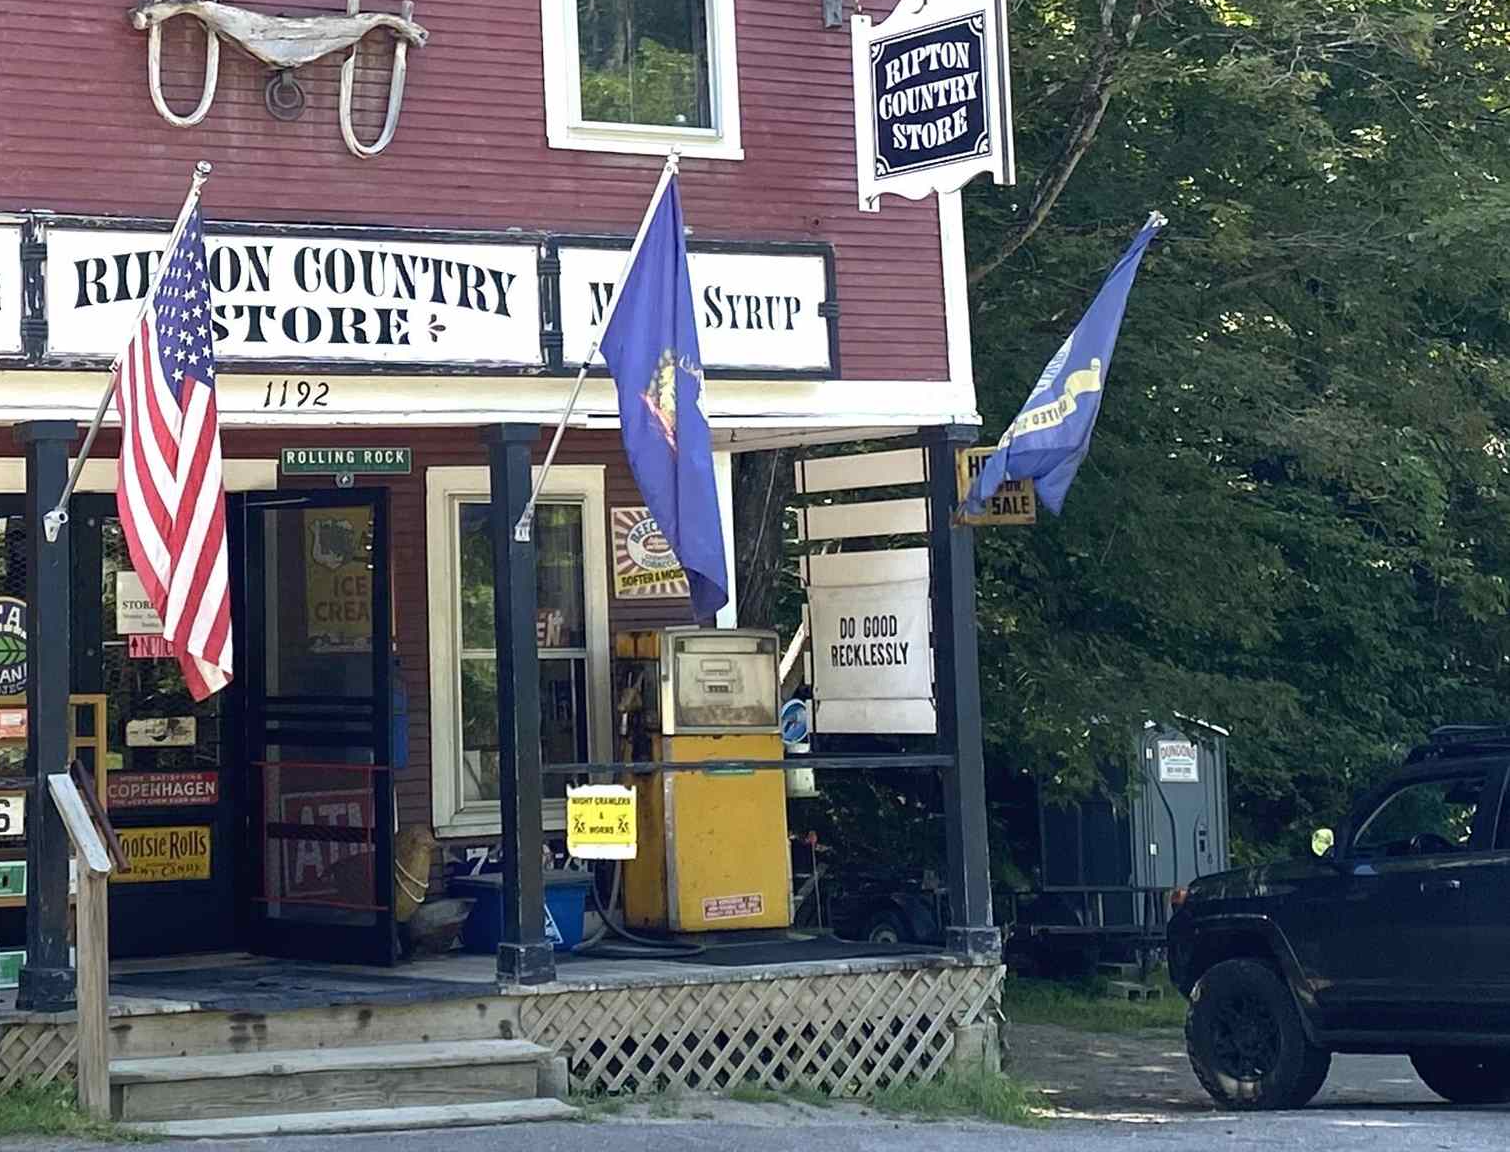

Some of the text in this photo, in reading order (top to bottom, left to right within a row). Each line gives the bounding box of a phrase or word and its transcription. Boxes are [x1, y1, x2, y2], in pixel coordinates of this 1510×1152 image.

[885, 42, 970, 89] RIPTON
[879, 72, 979, 120] COUNTRY
[892, 107, 968, 150] STORE
[294, 246, 517, 318] COUNTRY
[703, 285, 801, 330] SYRUP
[264, 381, 330, 408] 1192
[287, 451, 404, 464] ROLLING ROCK
[992, 496, 1029, 516] SALE
[622, 572, 654, 587] SOFTER
[840, 615, 897, 638] DO GOOD
[831, 643, 909, 666] RECKLESSLY
[108, 781, 216, 798] COPENHAGEN
[169, 830, 207, 859] Rolls
